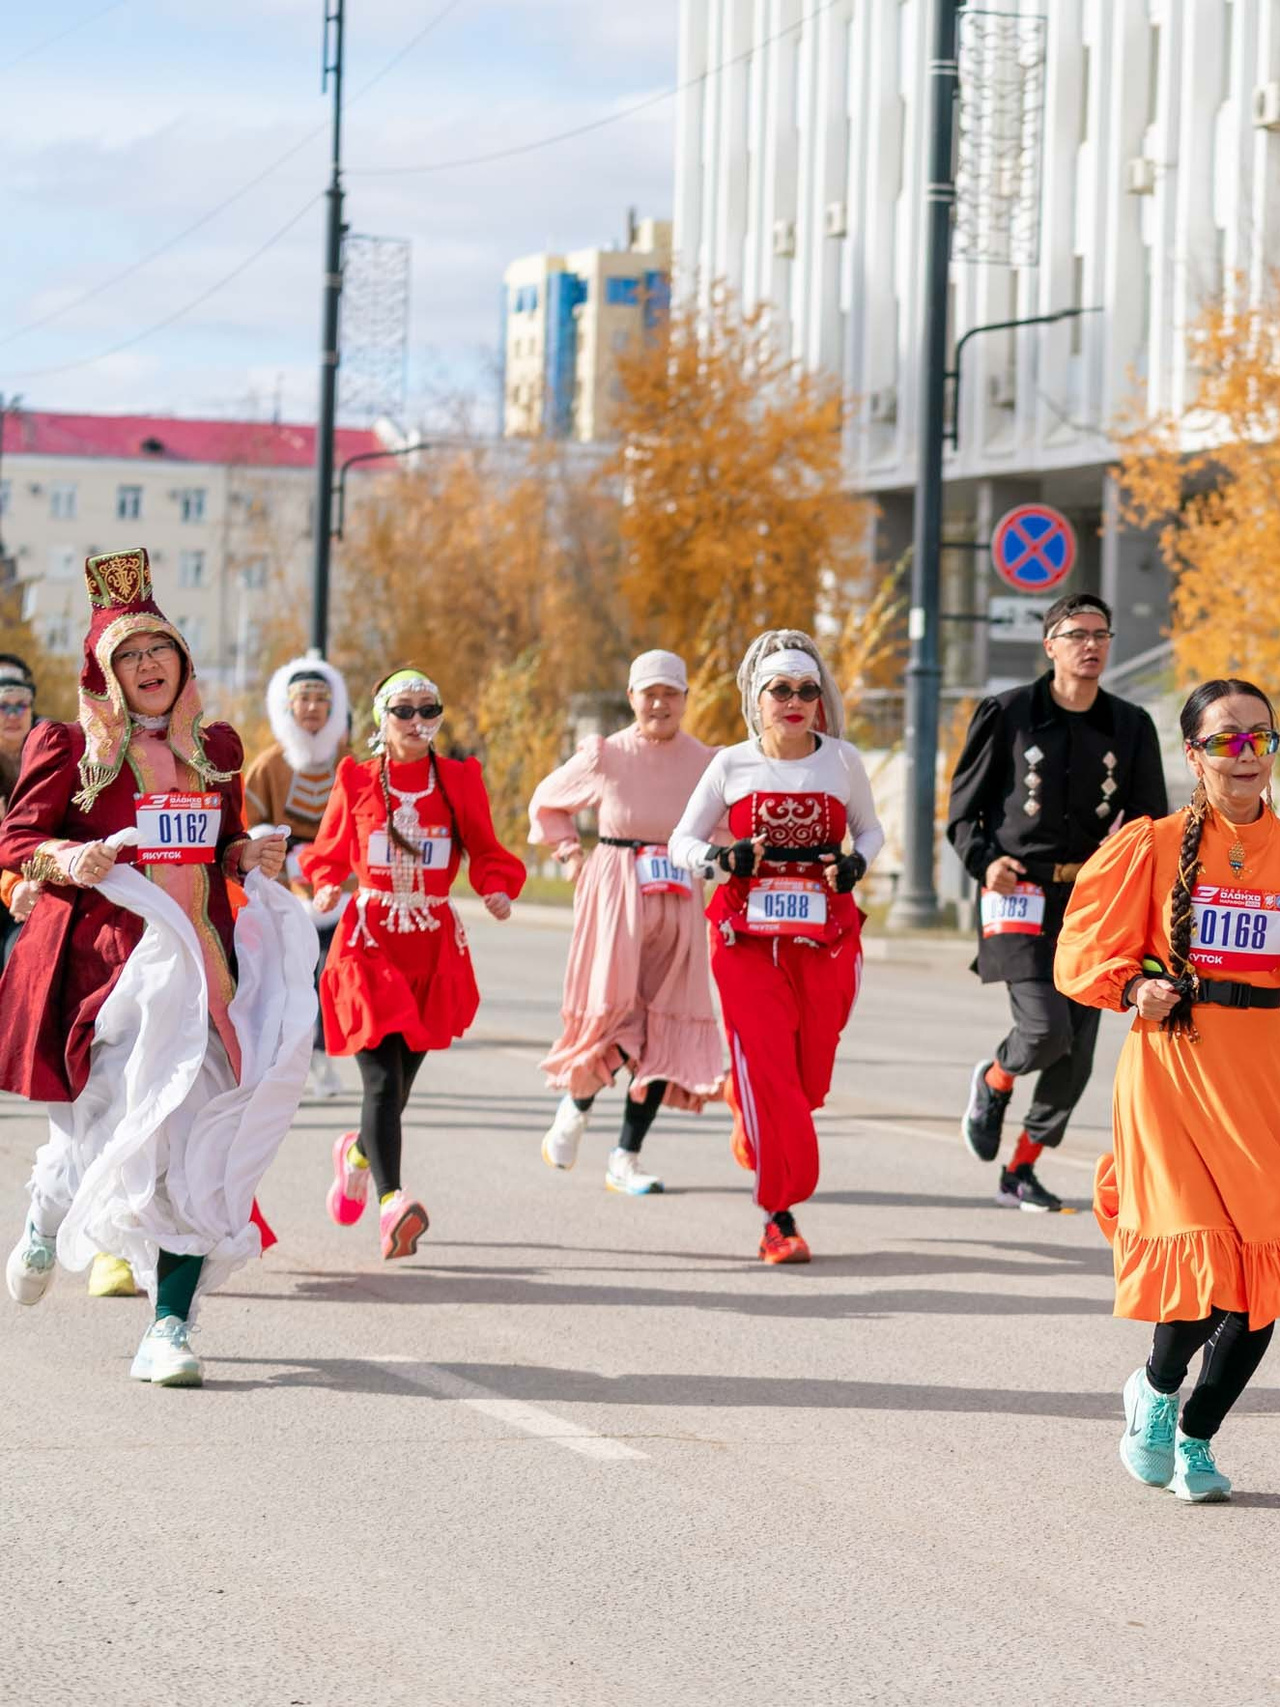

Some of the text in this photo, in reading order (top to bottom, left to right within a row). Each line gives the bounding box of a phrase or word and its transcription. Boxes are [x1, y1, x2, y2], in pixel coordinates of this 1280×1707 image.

[159, 813, 207, 843] 0162
[142, 851, 182, 860] ЯКУТСК
[764, 893, 809, 918] 0588
[1220, 892, 1261, 902] ОЛОНХО
[1200, 909, 1268, 950] 0168
